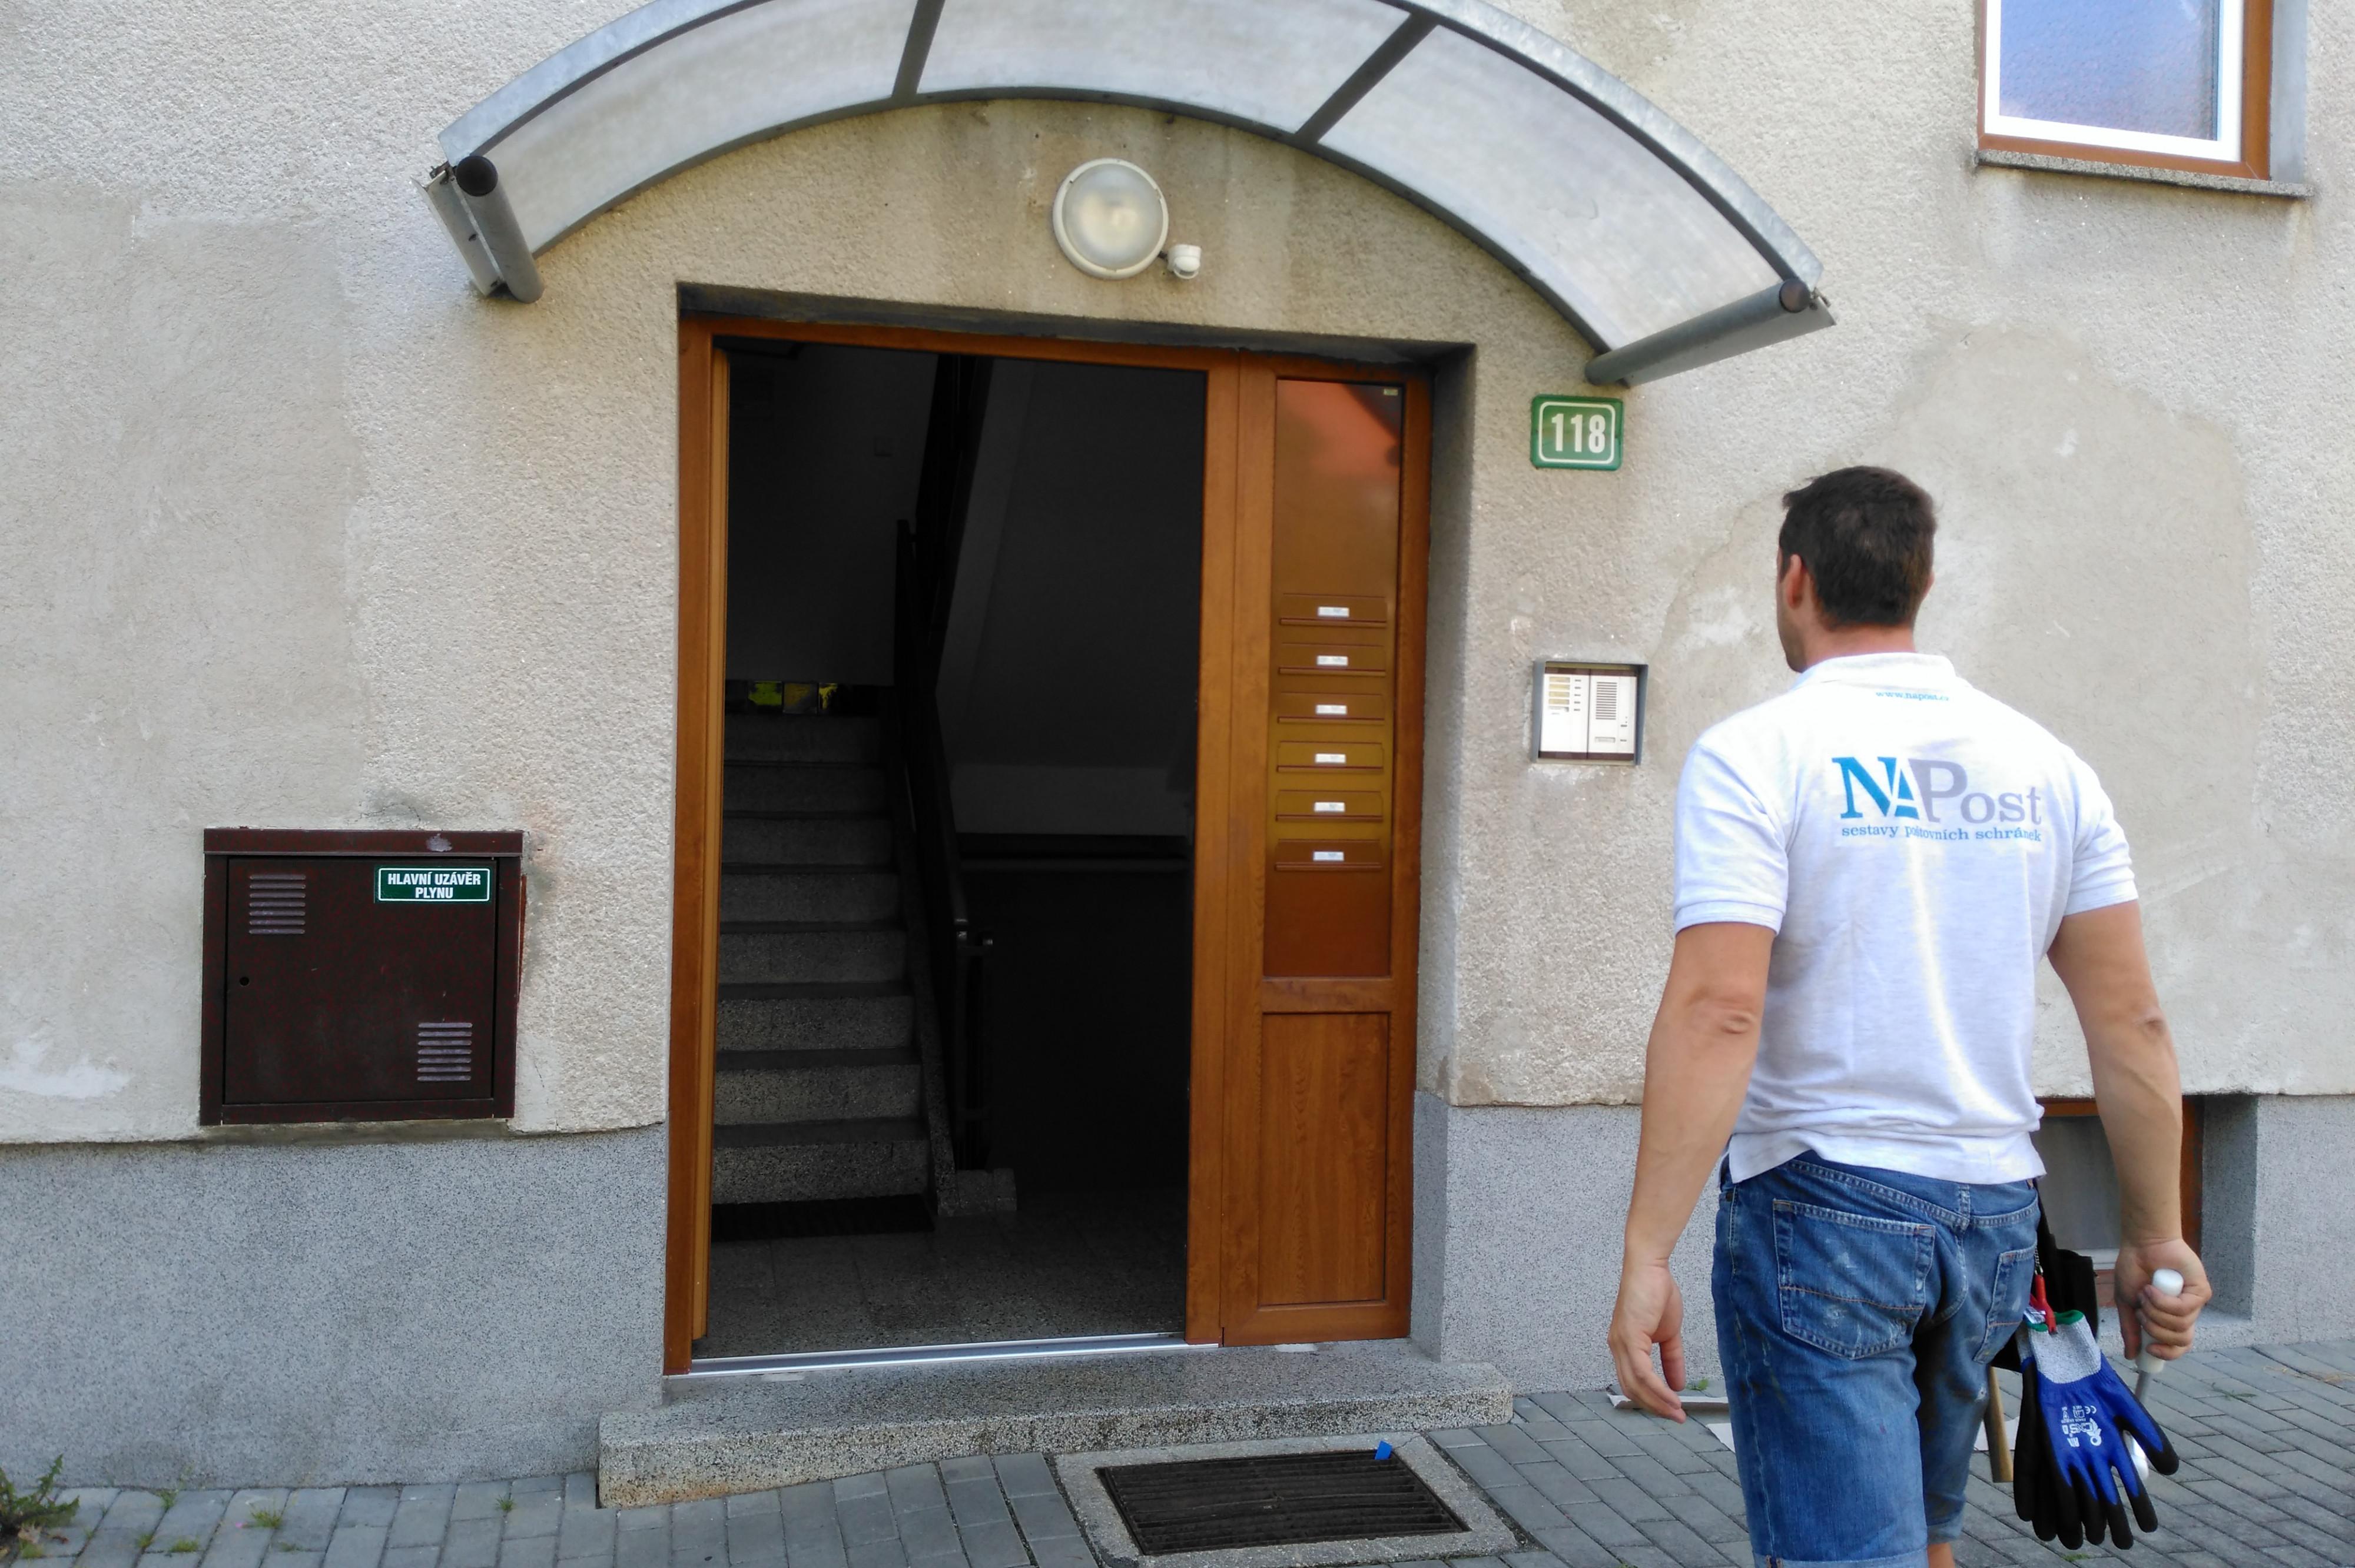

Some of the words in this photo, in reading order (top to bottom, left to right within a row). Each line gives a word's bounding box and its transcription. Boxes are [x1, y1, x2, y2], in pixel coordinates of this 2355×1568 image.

[1551, 413, 1606, 453] 118
[1842, 824, 1899, 838] sestavy
[1975, 827, 2042, 842] schránek
[387, 872, 433, 885] HLAVNÍ
[434, 872, 481, 885] UZÁVĚR
[415, 887, 453, 899] PLYNU
